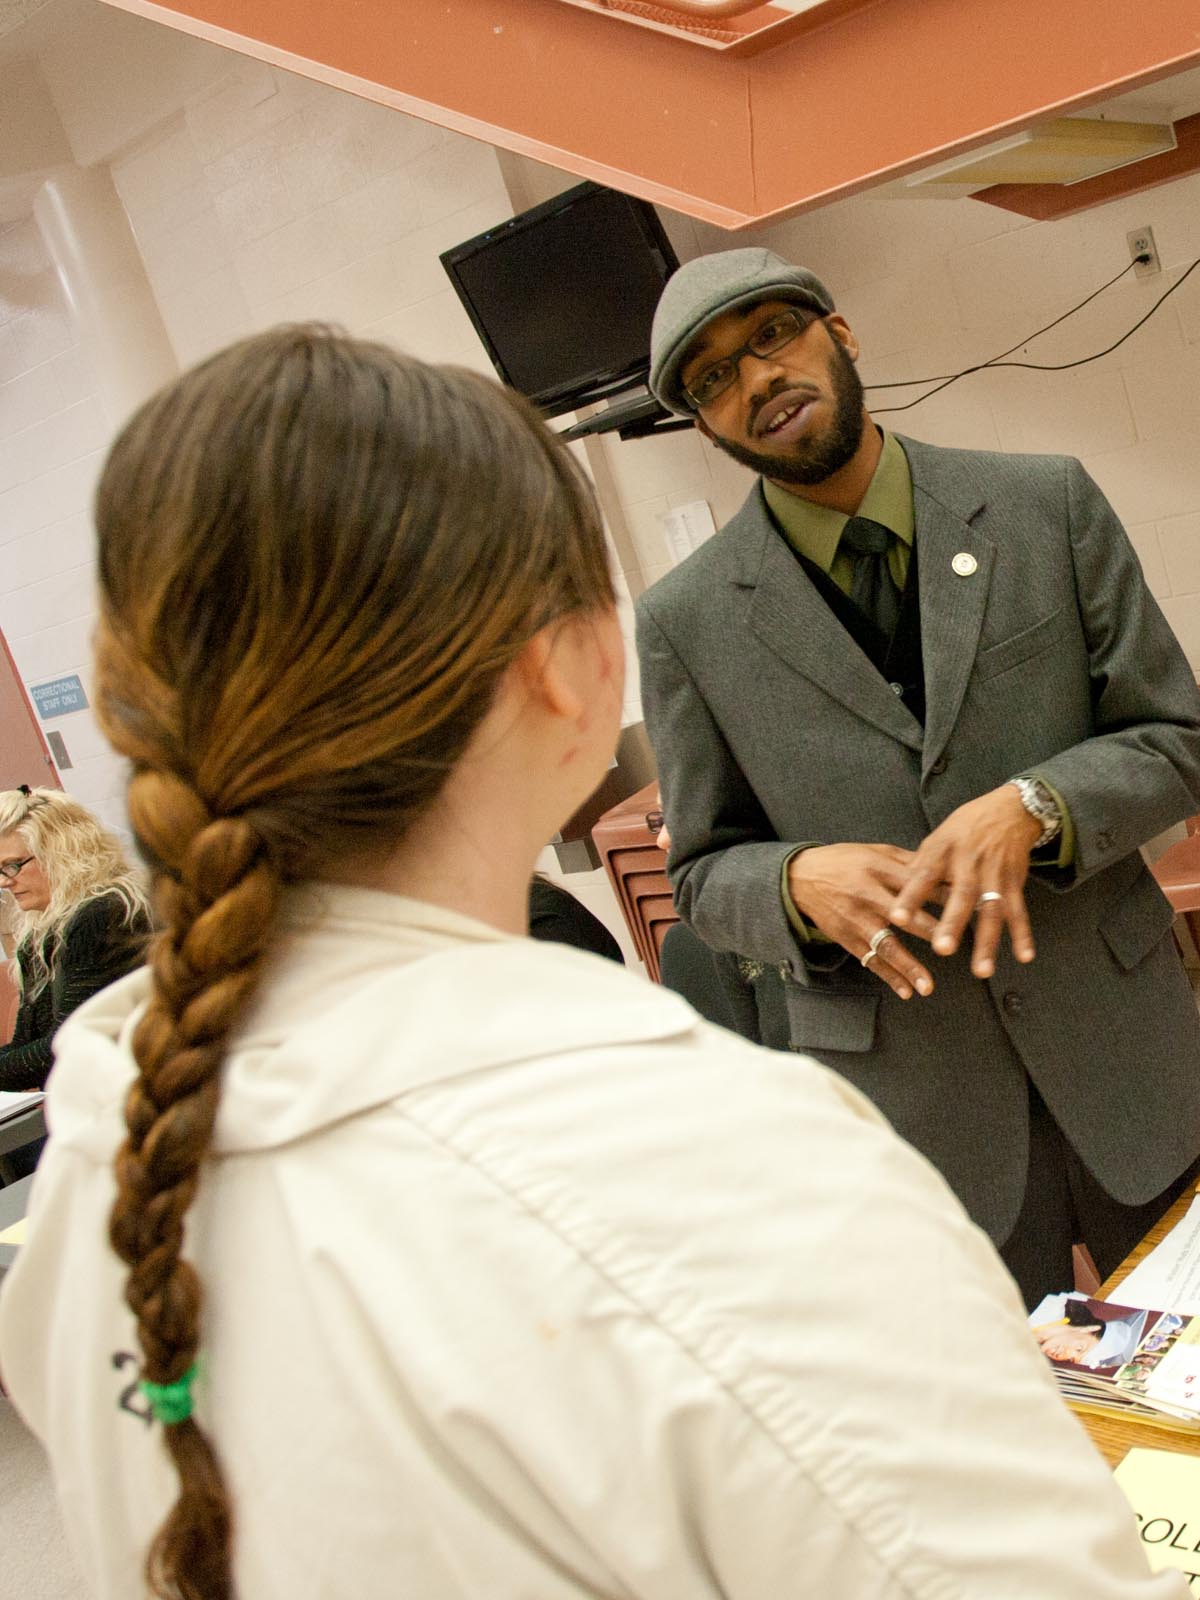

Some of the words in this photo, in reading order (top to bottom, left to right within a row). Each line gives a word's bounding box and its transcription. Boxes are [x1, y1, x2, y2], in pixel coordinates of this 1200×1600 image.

[33, 680, 80, 700] CORRECTIONAL
[42, 696, 60, 711] STAFF
[62, 694, 78, 706] ONLY
